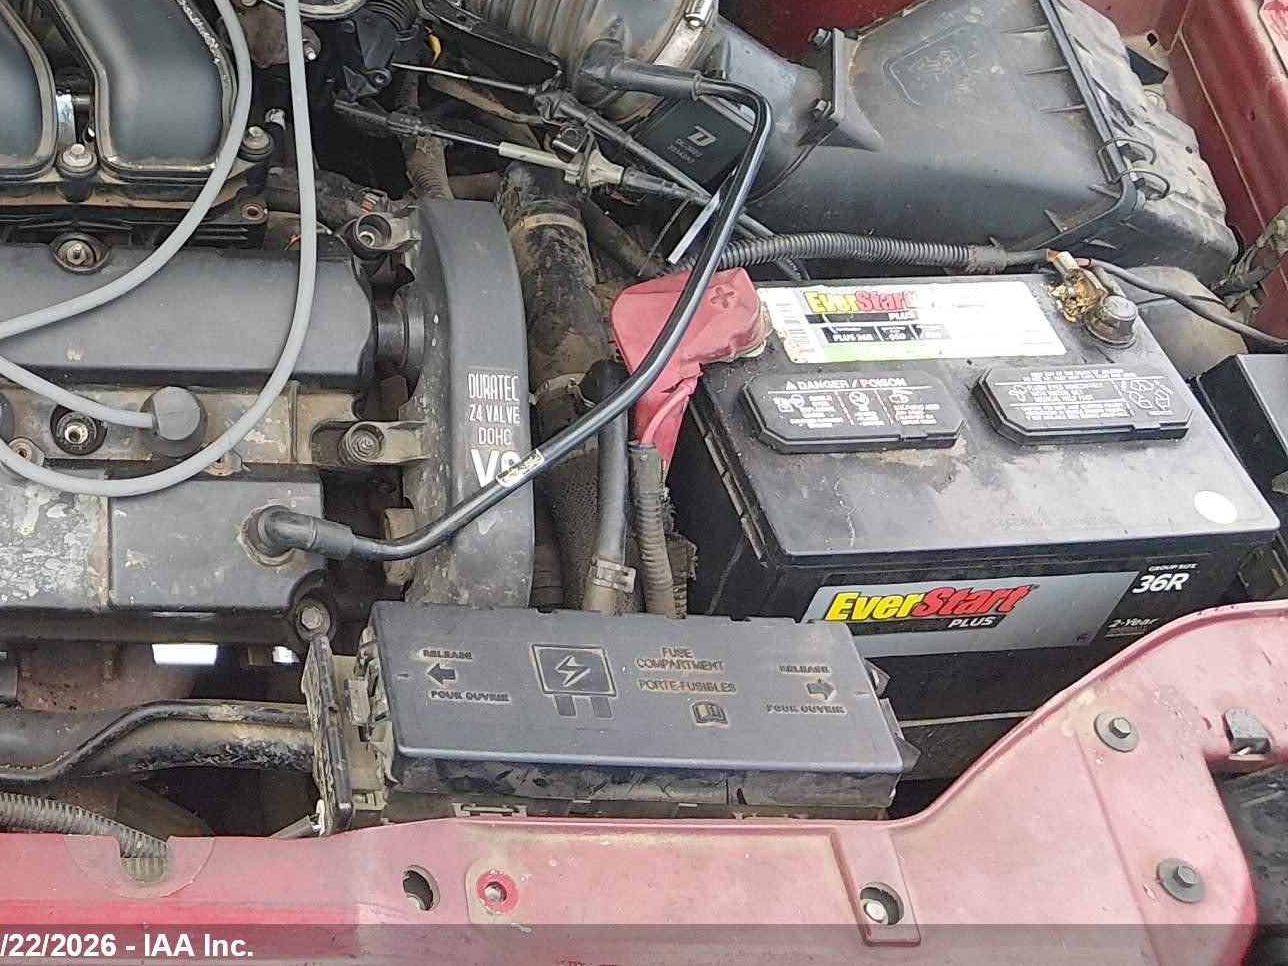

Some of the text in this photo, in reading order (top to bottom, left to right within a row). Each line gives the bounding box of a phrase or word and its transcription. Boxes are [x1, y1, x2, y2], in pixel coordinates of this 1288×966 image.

[468, 373, 520, 402] DURATEC
[797, 379, 849, 390] DANGER
[860, 378, 907, 387] POISON
[469, 405, 520, 424] 24 VALVE
[478, 426, 512, 445] DOHC
[1132, 573, 1189, 594] 36R
[825, 584, 1033, 622] EverStart
[948, 617, 996, 629] PLUS
[662, 647, 693, 658] FUSE
[636, 658, 724, 671] COMPARTMENT
[639, 679, 736, 693] PORTE-FUSIBLES
